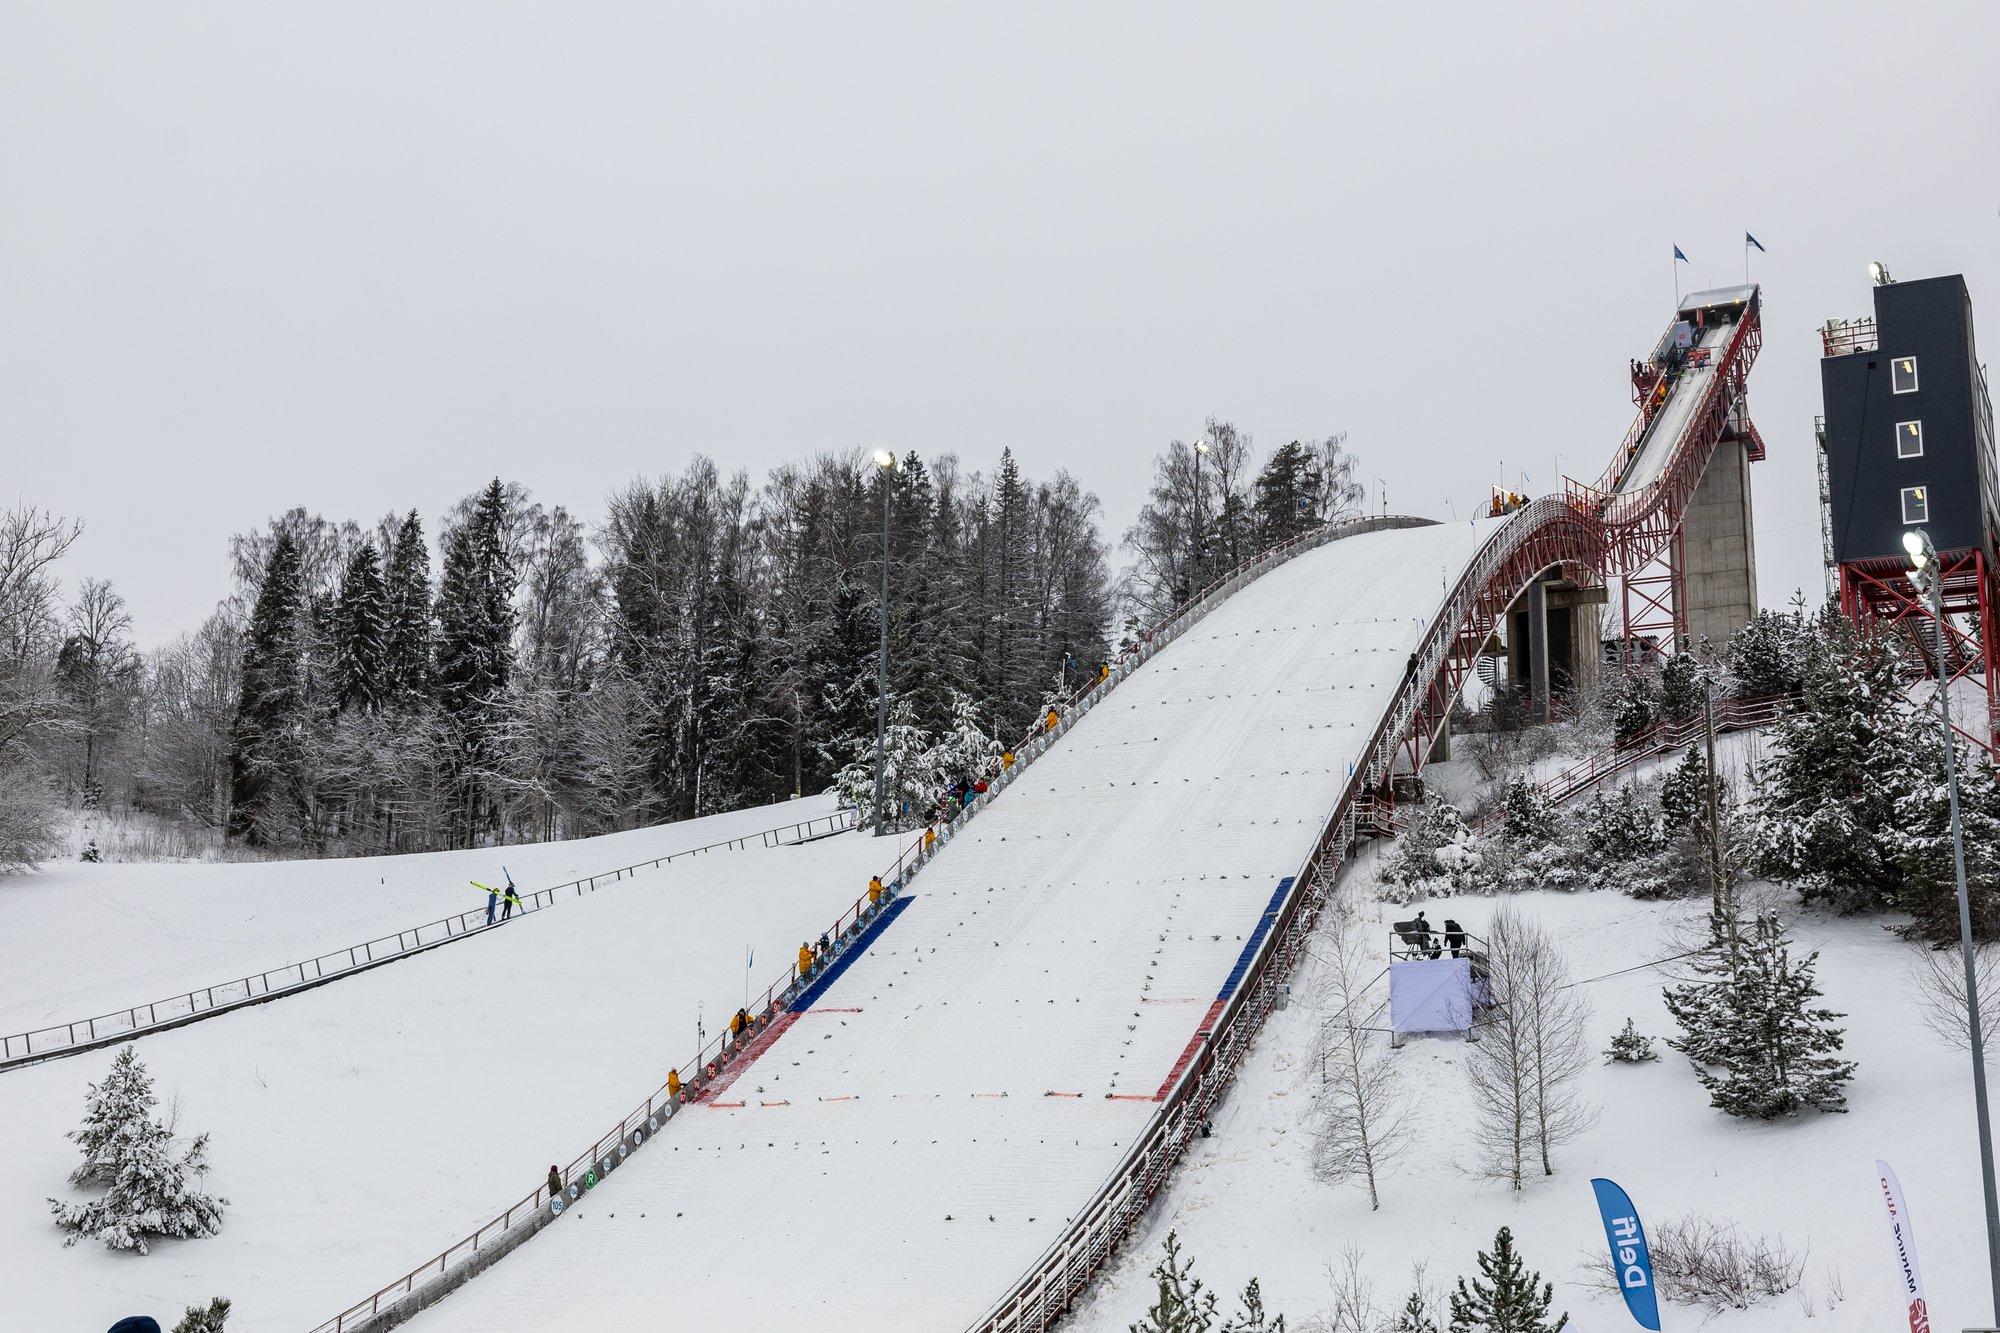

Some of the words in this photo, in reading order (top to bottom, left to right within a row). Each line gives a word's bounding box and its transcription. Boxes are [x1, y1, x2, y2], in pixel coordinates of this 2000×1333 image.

[707, 1066, 716, 1077] 95
[588, 1173, 594, 1184] R
[552, 1199, 563, 1211] 105
